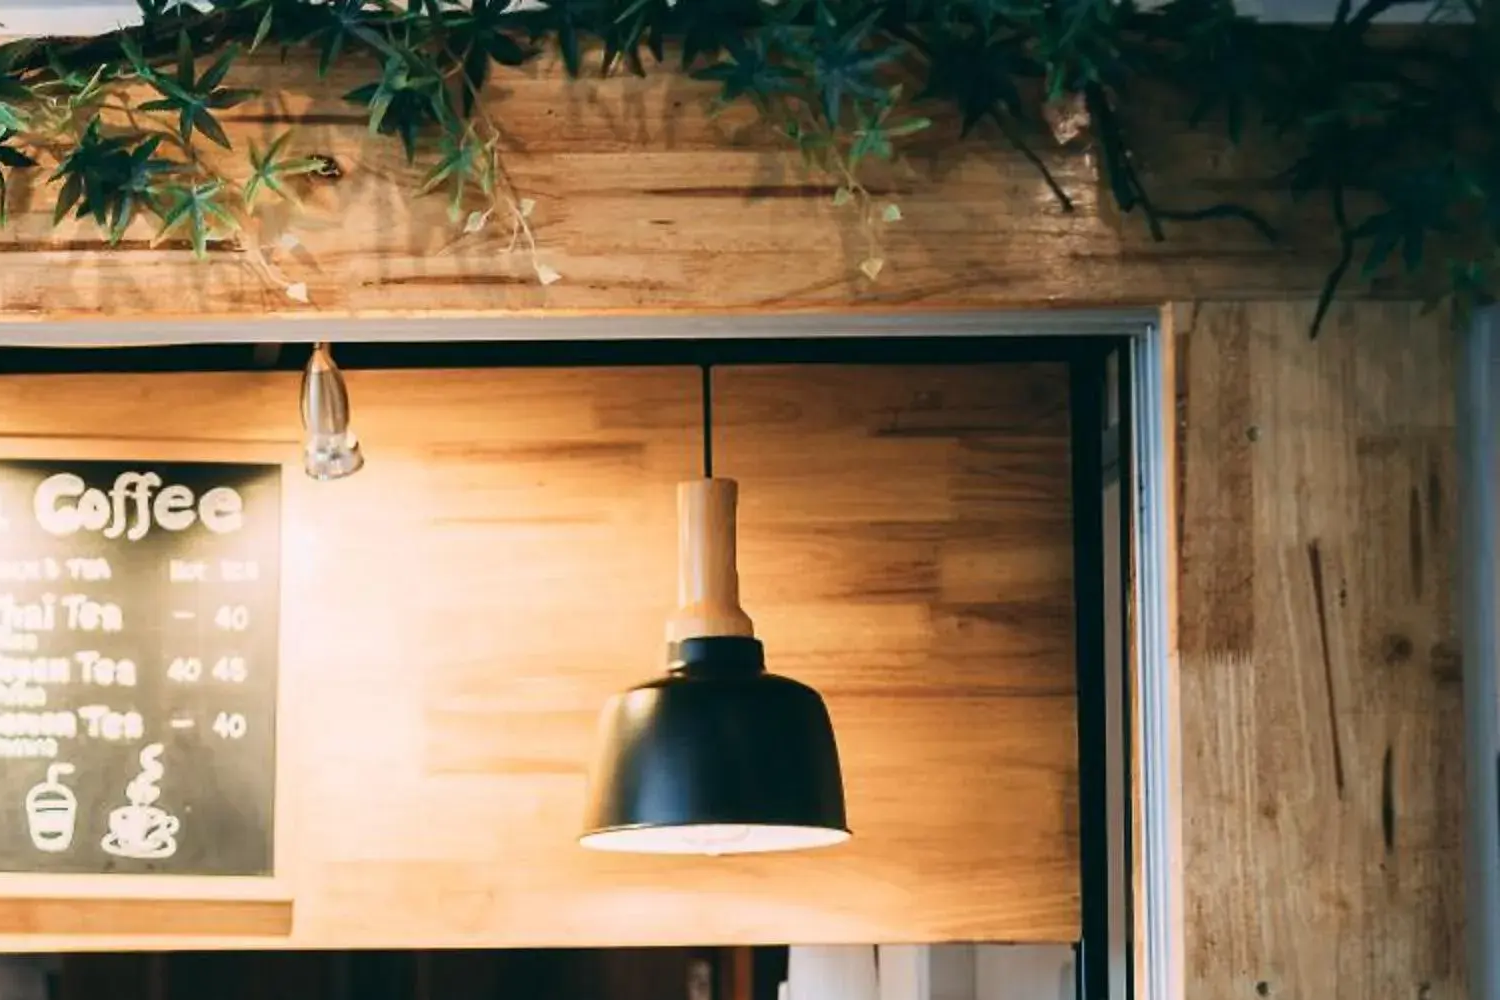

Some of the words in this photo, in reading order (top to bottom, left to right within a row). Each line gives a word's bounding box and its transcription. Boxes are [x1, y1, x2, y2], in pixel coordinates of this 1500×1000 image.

[34, 471, 243, 541] Coffee
[61, 594, 125, 633] Tea
[214, 603, 249, 632] 40
[74, 650, 137, 687] Tea
[166, 656, 202, 683] 40
[78, 704, 145, 741] Tea
[213, 710, 248, 740] 40
